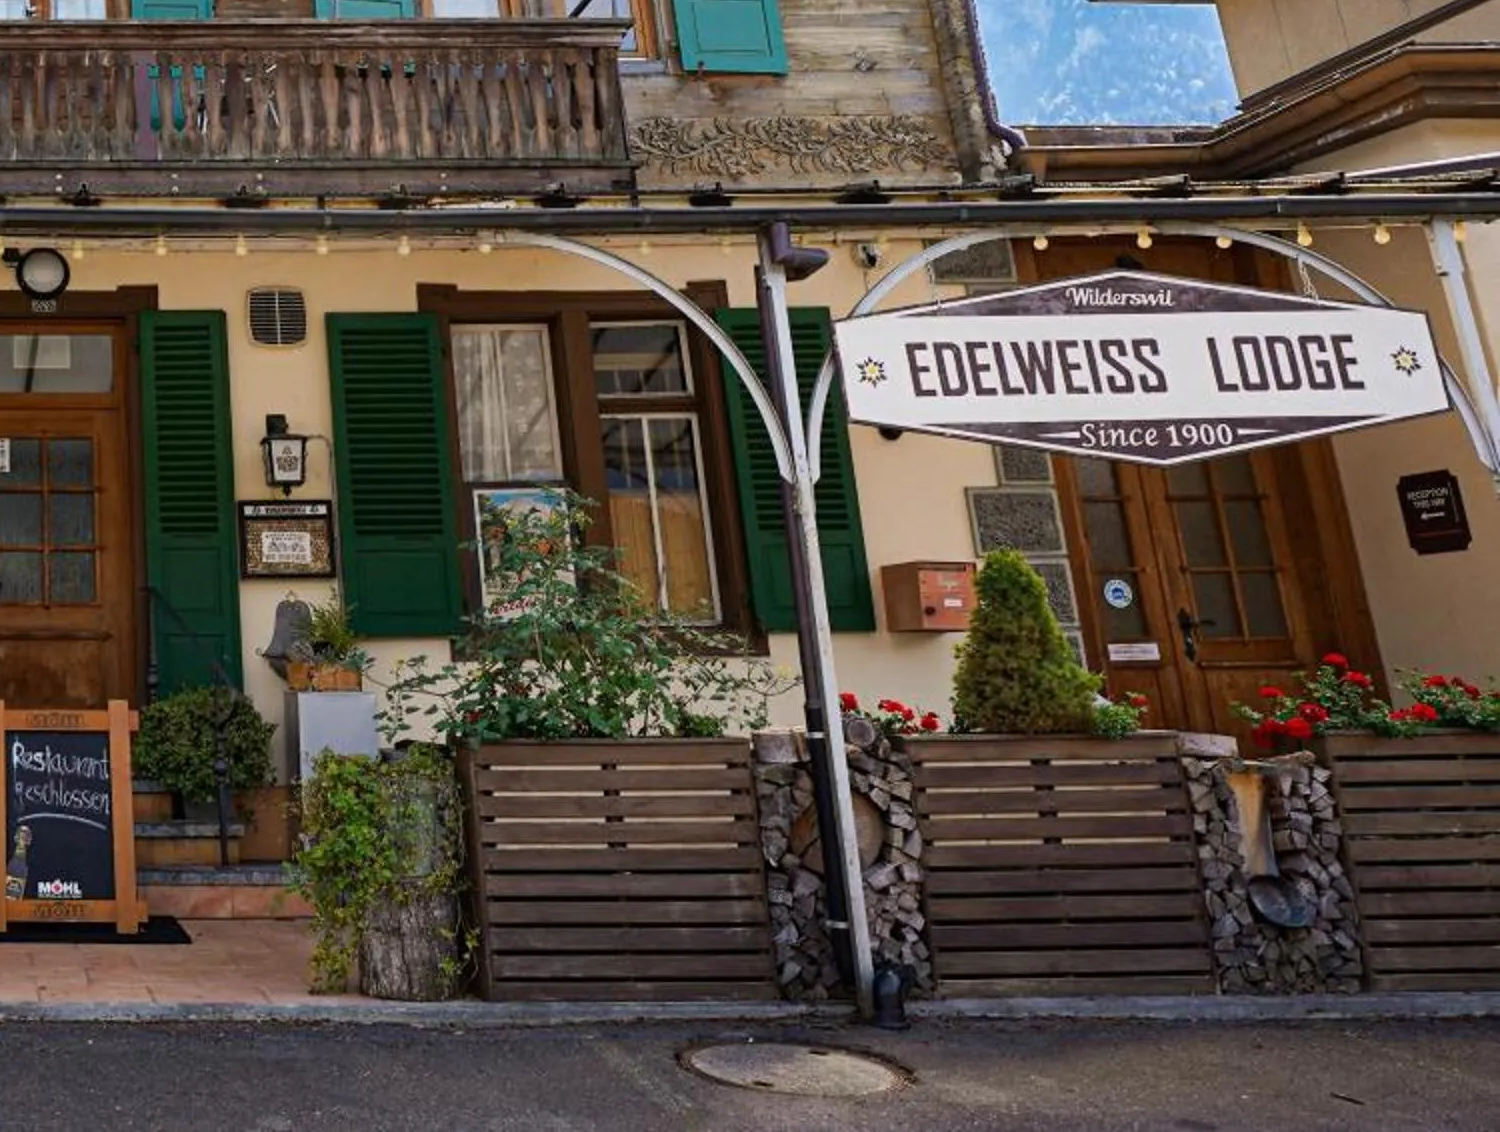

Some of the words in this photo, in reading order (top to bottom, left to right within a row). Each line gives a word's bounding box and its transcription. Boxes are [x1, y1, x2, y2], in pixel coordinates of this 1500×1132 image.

[1065, 287, 1176, 307] Wilderswil
[905, 338, 1168, 397] EDELWEISS
[1206, 333, 1365, 392] LODGE
[1081, 423, 1159, 448] Since
[1167, 422, 1233, 446] 1900
[11, 739, 109, 781] Restaurant
